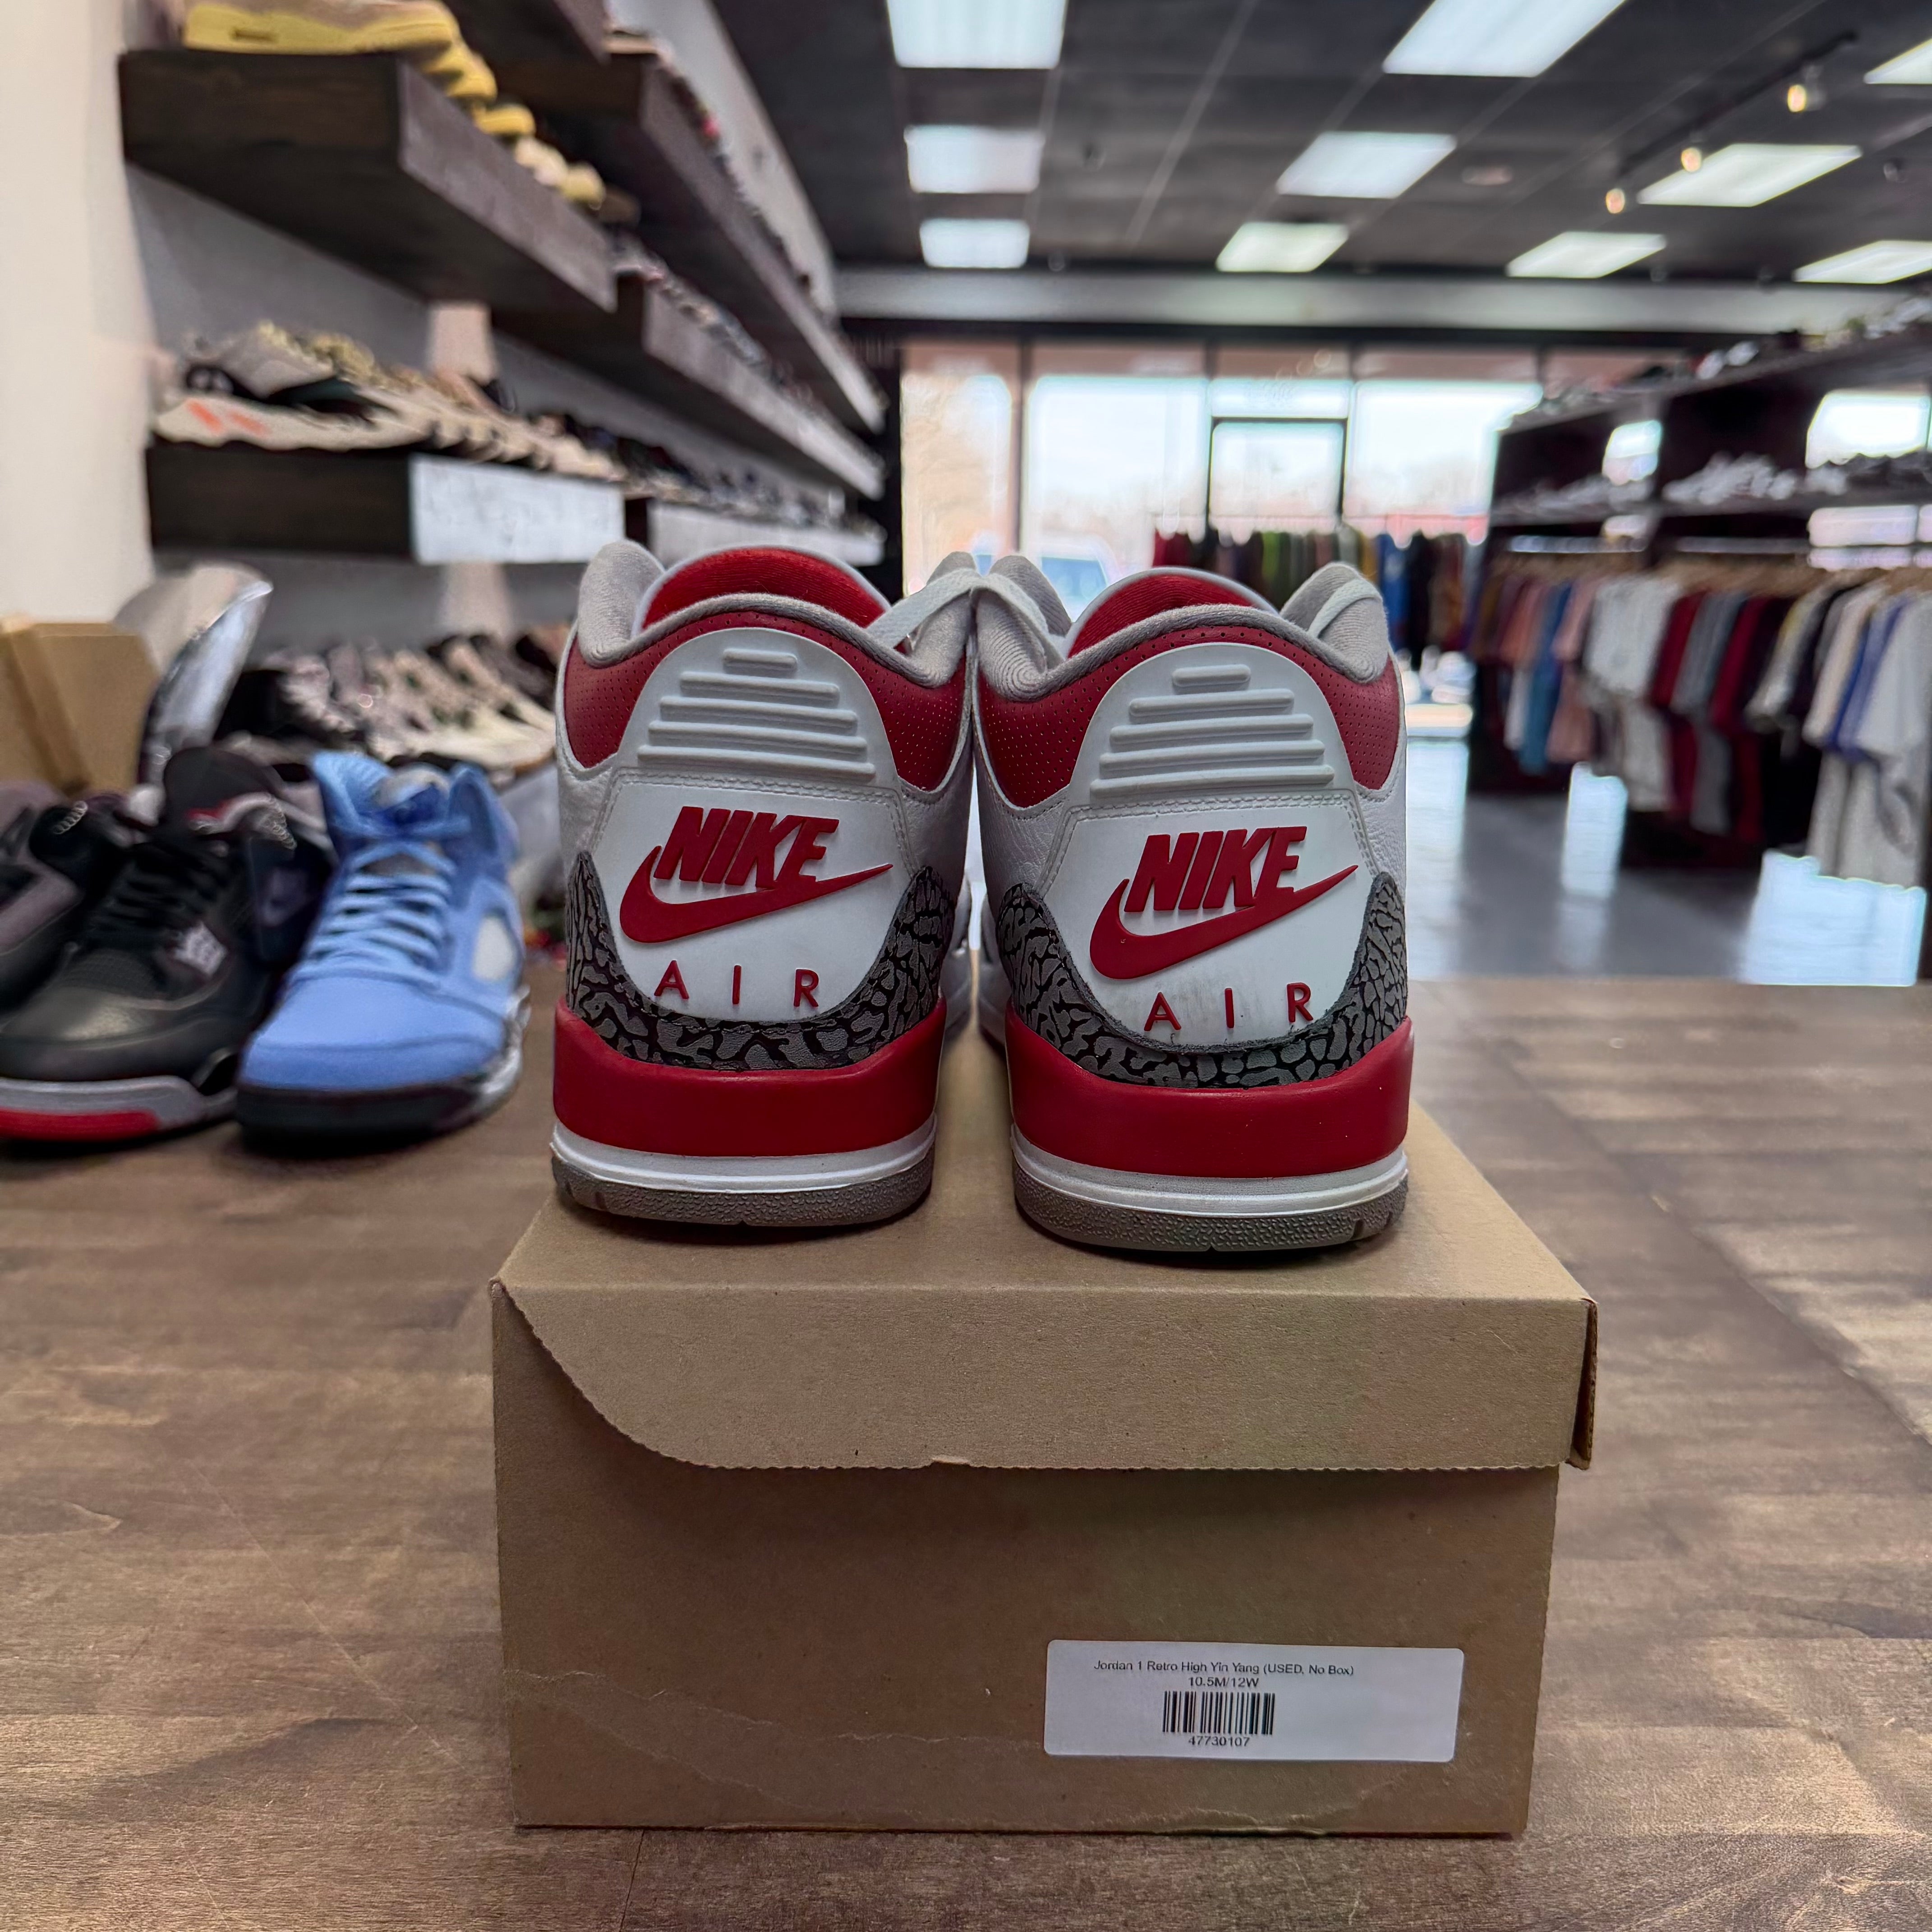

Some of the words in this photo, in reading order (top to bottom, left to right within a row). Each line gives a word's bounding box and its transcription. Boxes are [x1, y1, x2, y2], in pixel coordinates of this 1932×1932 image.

[653, 806, 840, 889] NIKE
[1124, 826, 1307, 912] NIKE
[654, 960, 819, 1007] AIR
[1144, 982, 1313, 1031] AIR
[1094, 1660, 1133, 1670] Jordan
[1138, 1661, 1142, 1670] 1
[1147, 1661, 1178, 1671] Retro
[1181, 1661, 1207, 1673] High
[1211, 1662, 1228, 1672] Yin
[1233, 1662, 1259, 1674] Yang
[1309, 1665, 1325, 1674] No
[1328, 1665, 1354, 1675] Box)
[1188, 1676, 1259, 1688] 10.5M/12W
[1188, 1736, 1250, 1747] 47730107
